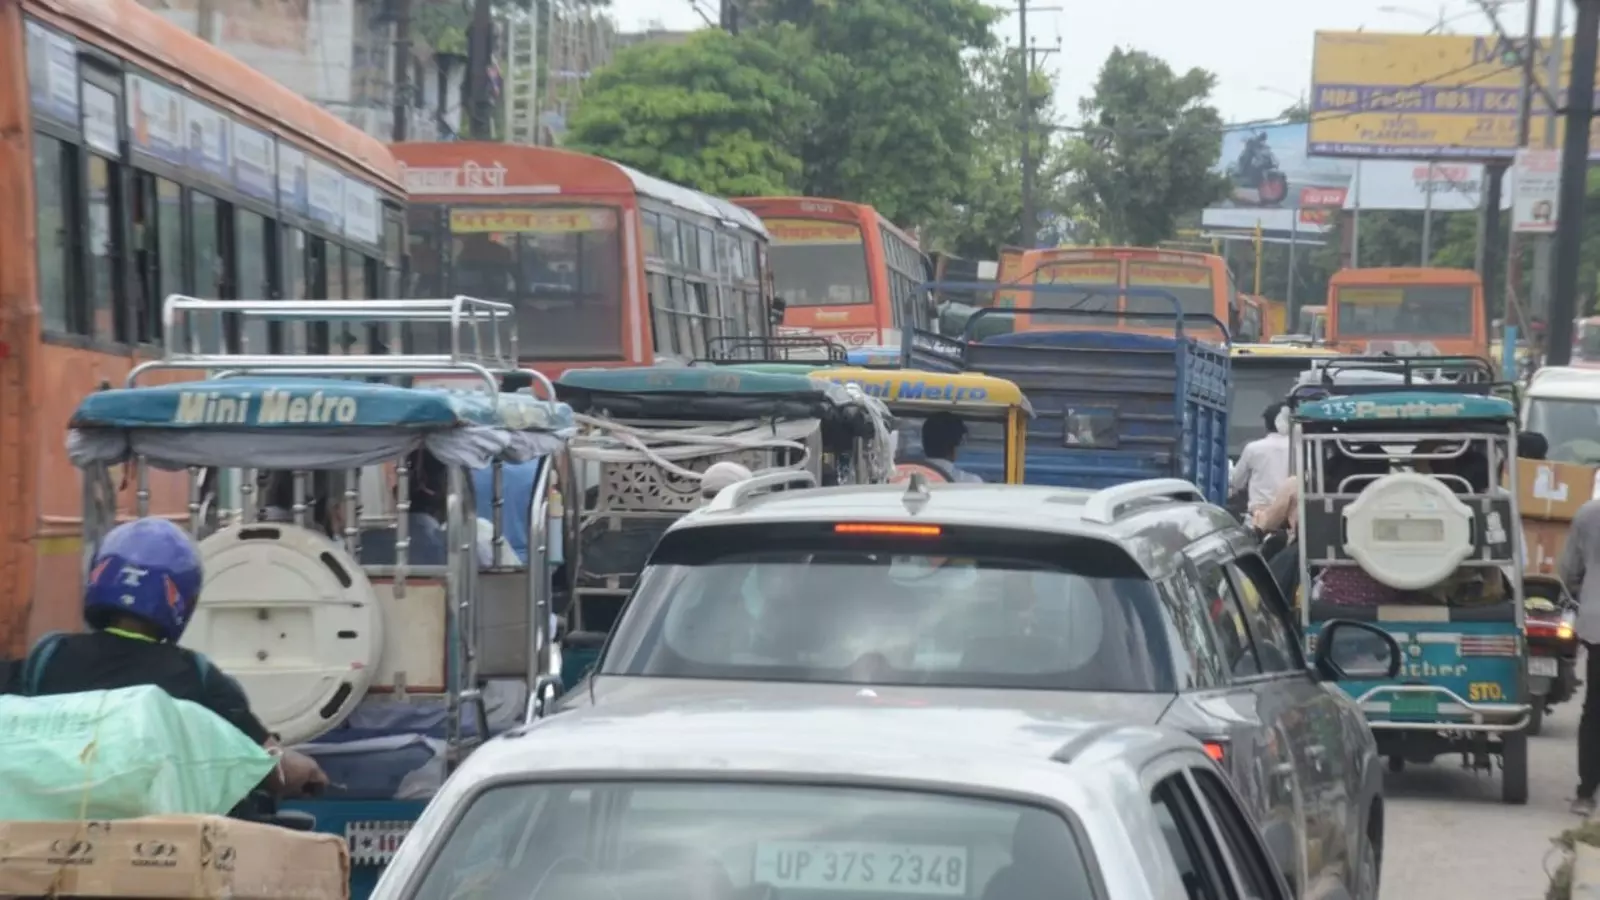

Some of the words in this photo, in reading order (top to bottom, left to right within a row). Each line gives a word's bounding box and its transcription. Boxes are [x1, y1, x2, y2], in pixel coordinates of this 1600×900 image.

[897, 380, 987, 400] Metro
[175, 391, 252, 424] Mini
[256, 388, 356, 424] Metro
[1356, 401, 1464, 418] Panther
[776, 851, 811, 881] UP
[822, 851, 875, 884] 37S
[888, 853, 962, 887] 2348
